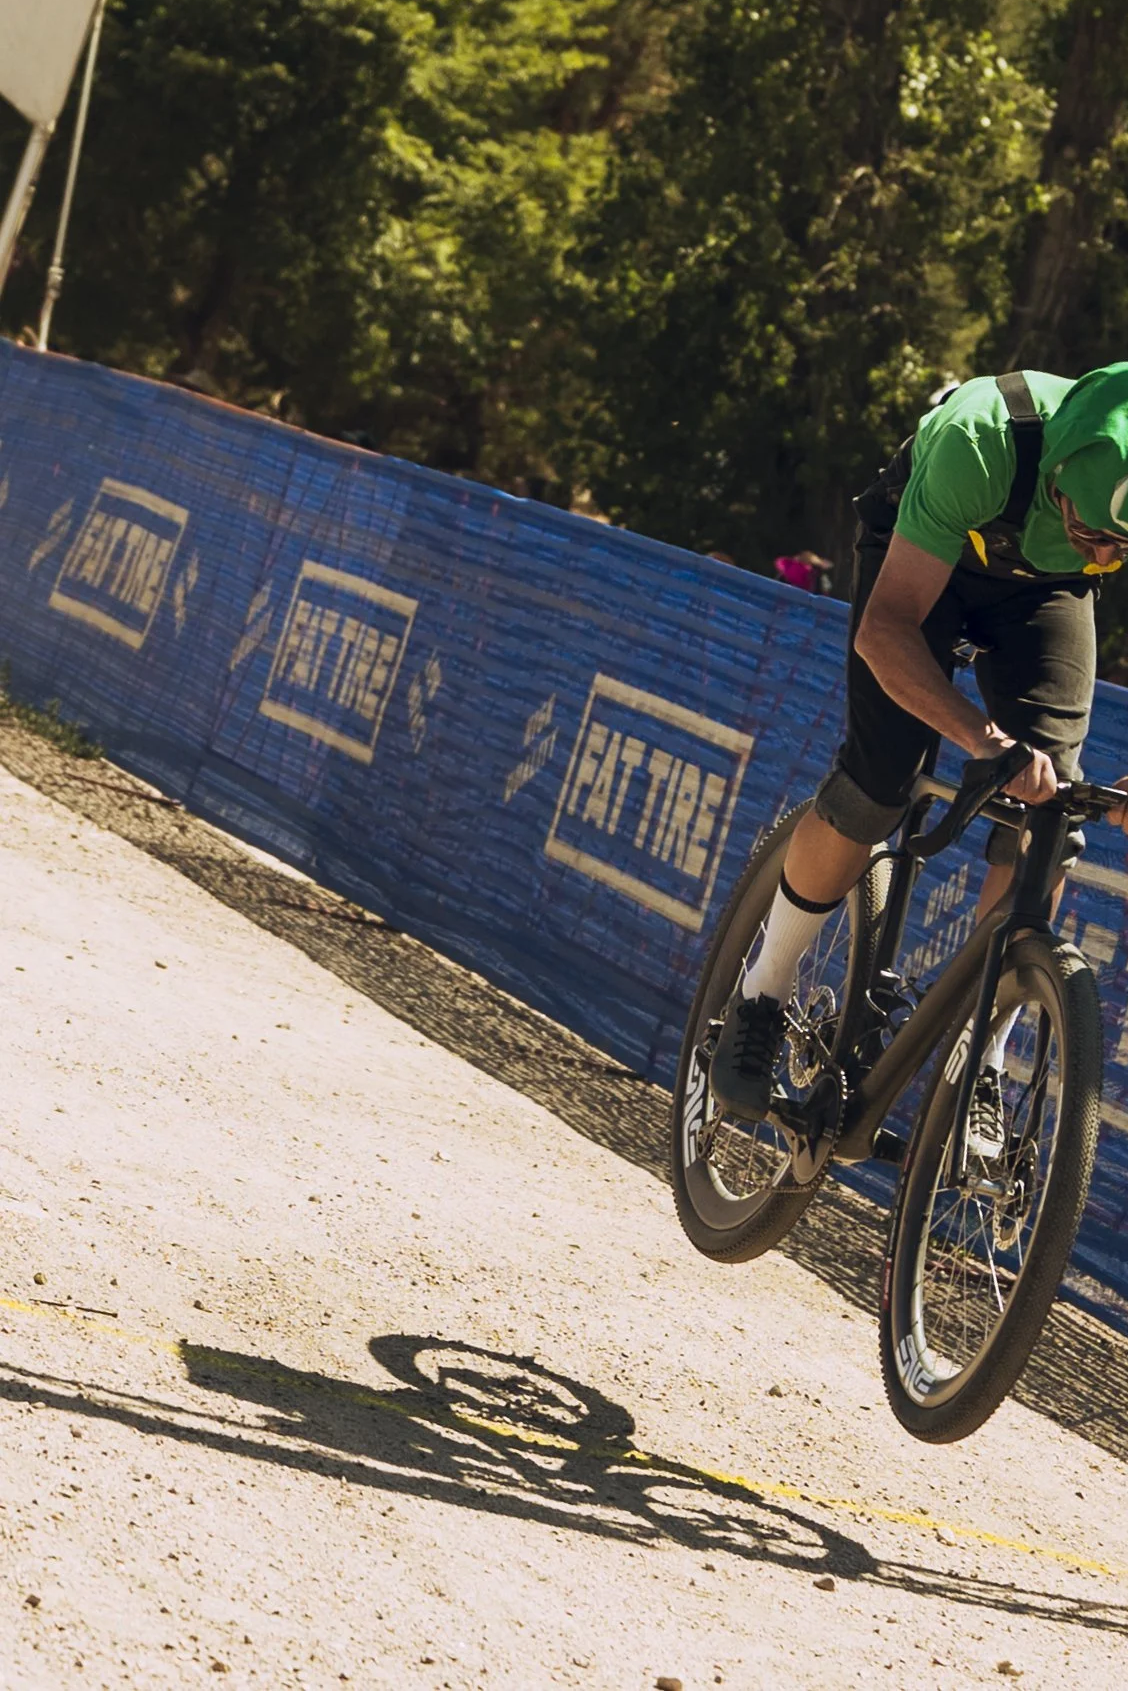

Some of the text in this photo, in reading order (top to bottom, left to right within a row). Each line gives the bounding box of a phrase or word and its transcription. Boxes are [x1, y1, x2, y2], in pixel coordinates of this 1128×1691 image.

[67, 511, 129, 589] FAT
[109, 523, 173, 613] TIRE
[278, 599, 340, 691] FAT
[328, 616, 398, 720] TIRE
[567, 721, 646, 835] FAT
[634, 748, 727, 878] TIRE
